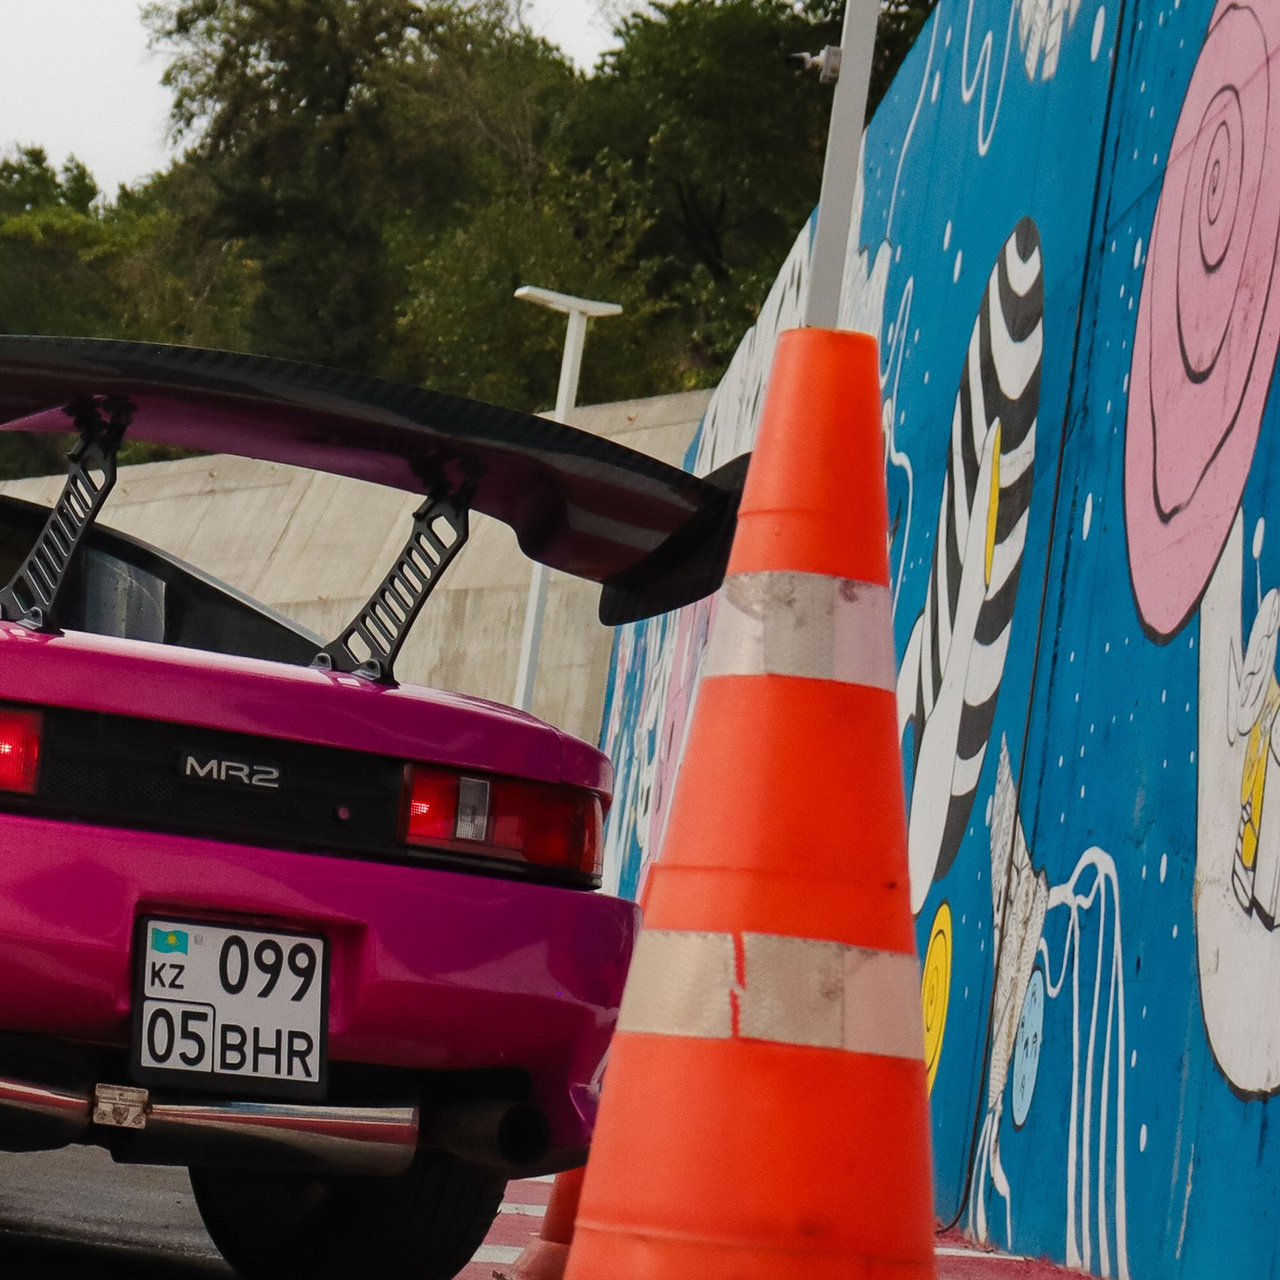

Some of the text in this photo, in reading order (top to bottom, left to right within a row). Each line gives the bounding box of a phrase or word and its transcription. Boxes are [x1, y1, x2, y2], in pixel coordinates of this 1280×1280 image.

[185, 755, 280, 788] MR2
[150, 961, 185, 990] KZ
[218, 934, 317, 1002] 099
[146, 1007, 314, 1078] 05 BHR
